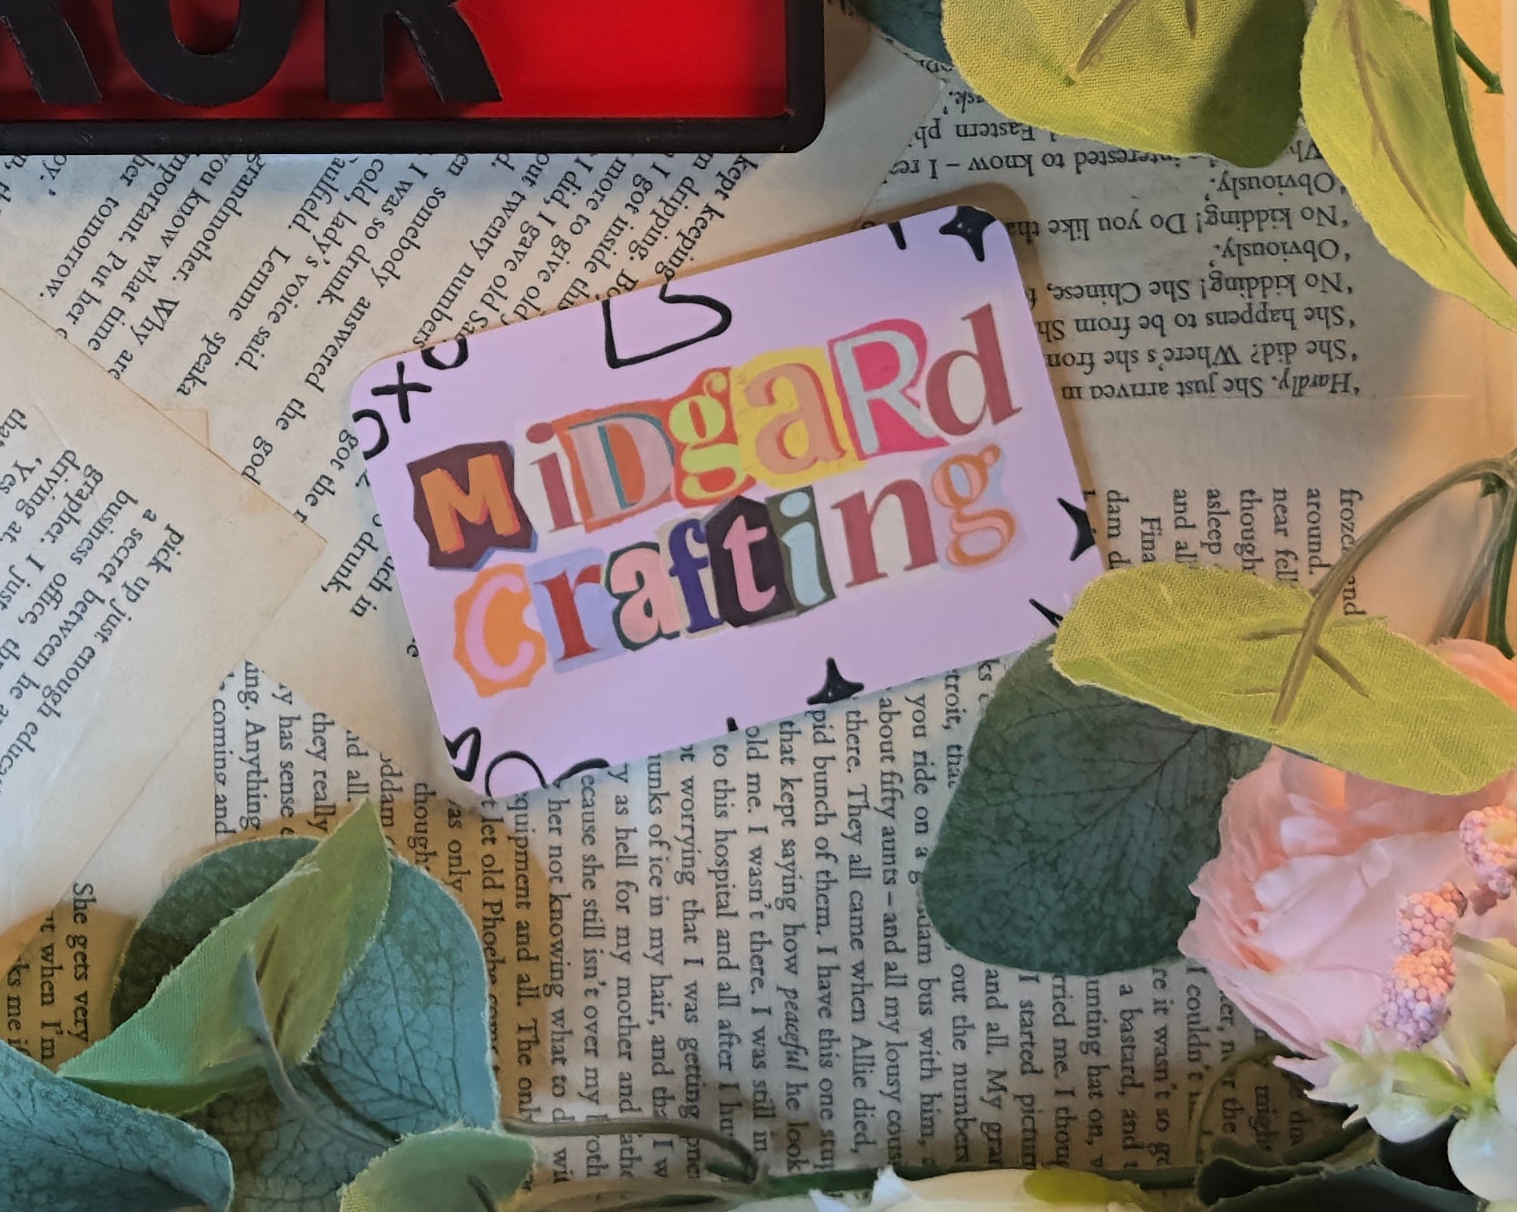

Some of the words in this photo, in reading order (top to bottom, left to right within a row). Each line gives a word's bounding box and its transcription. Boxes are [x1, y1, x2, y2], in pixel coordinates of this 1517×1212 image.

[343, 152, 384, 207] cold,
[407, 162, 429, 179] I
[380, 179, 414, 216] was
[1096, 207, 1143, 231] you
[1195, 204, 1293, 234] kidding!
[364, 217, 385, 240] so
[1047, 217, 1090, 242] like
[1149, 212, 1188, 235] Do
[39, 196, 120, 298] tomorrow.
[316, 244, 371, 305] drunk.
[1046, 281, 1141, 306] Chinese,
[1148, 279, 1191, 303] She
[1198, 269, 1297, 300] kidding!
[267, 273, 309, 324] voice
[234, 325, 271, 371] said.
[1103, 349, 1139, 373] she
[1250, 341, 1297, 366] did?
[1175, 371, 1219, 398] just
[1222, 376, 1263, 399] She
[1199, 488, 1231, 555] asleep
[1272, 487, 1289, 537] near
[1306, 487, 1333, 575] around.
[146, 523, 185, 573] pick
[454, 445, 1021, 688] Crafting
[120, 576, 150, 603] up
[93, 597, 130, 643] just
[36, 645, 96, 718] enough
[778, 720, 802, 765] that
[772, 776, 803, 827] kept
[673, 775, 702, 886] worrying
[774, 838, 803, 912] saying
[681, 899, 705, 944] that
[683, 956, 704, 967] I
[782, 922, 807, 976] how
[683, 979, 699, 1023] was
[984, 968, 1009, 1010] and
[775, 984, 808, 1072] peaceful
[985, 1021, 1009, 1055] all.
[676, 1037, 707, 1120] getting
[785, 1081, 808, 1111] he
[978, 1068, 1008, 1111] My
